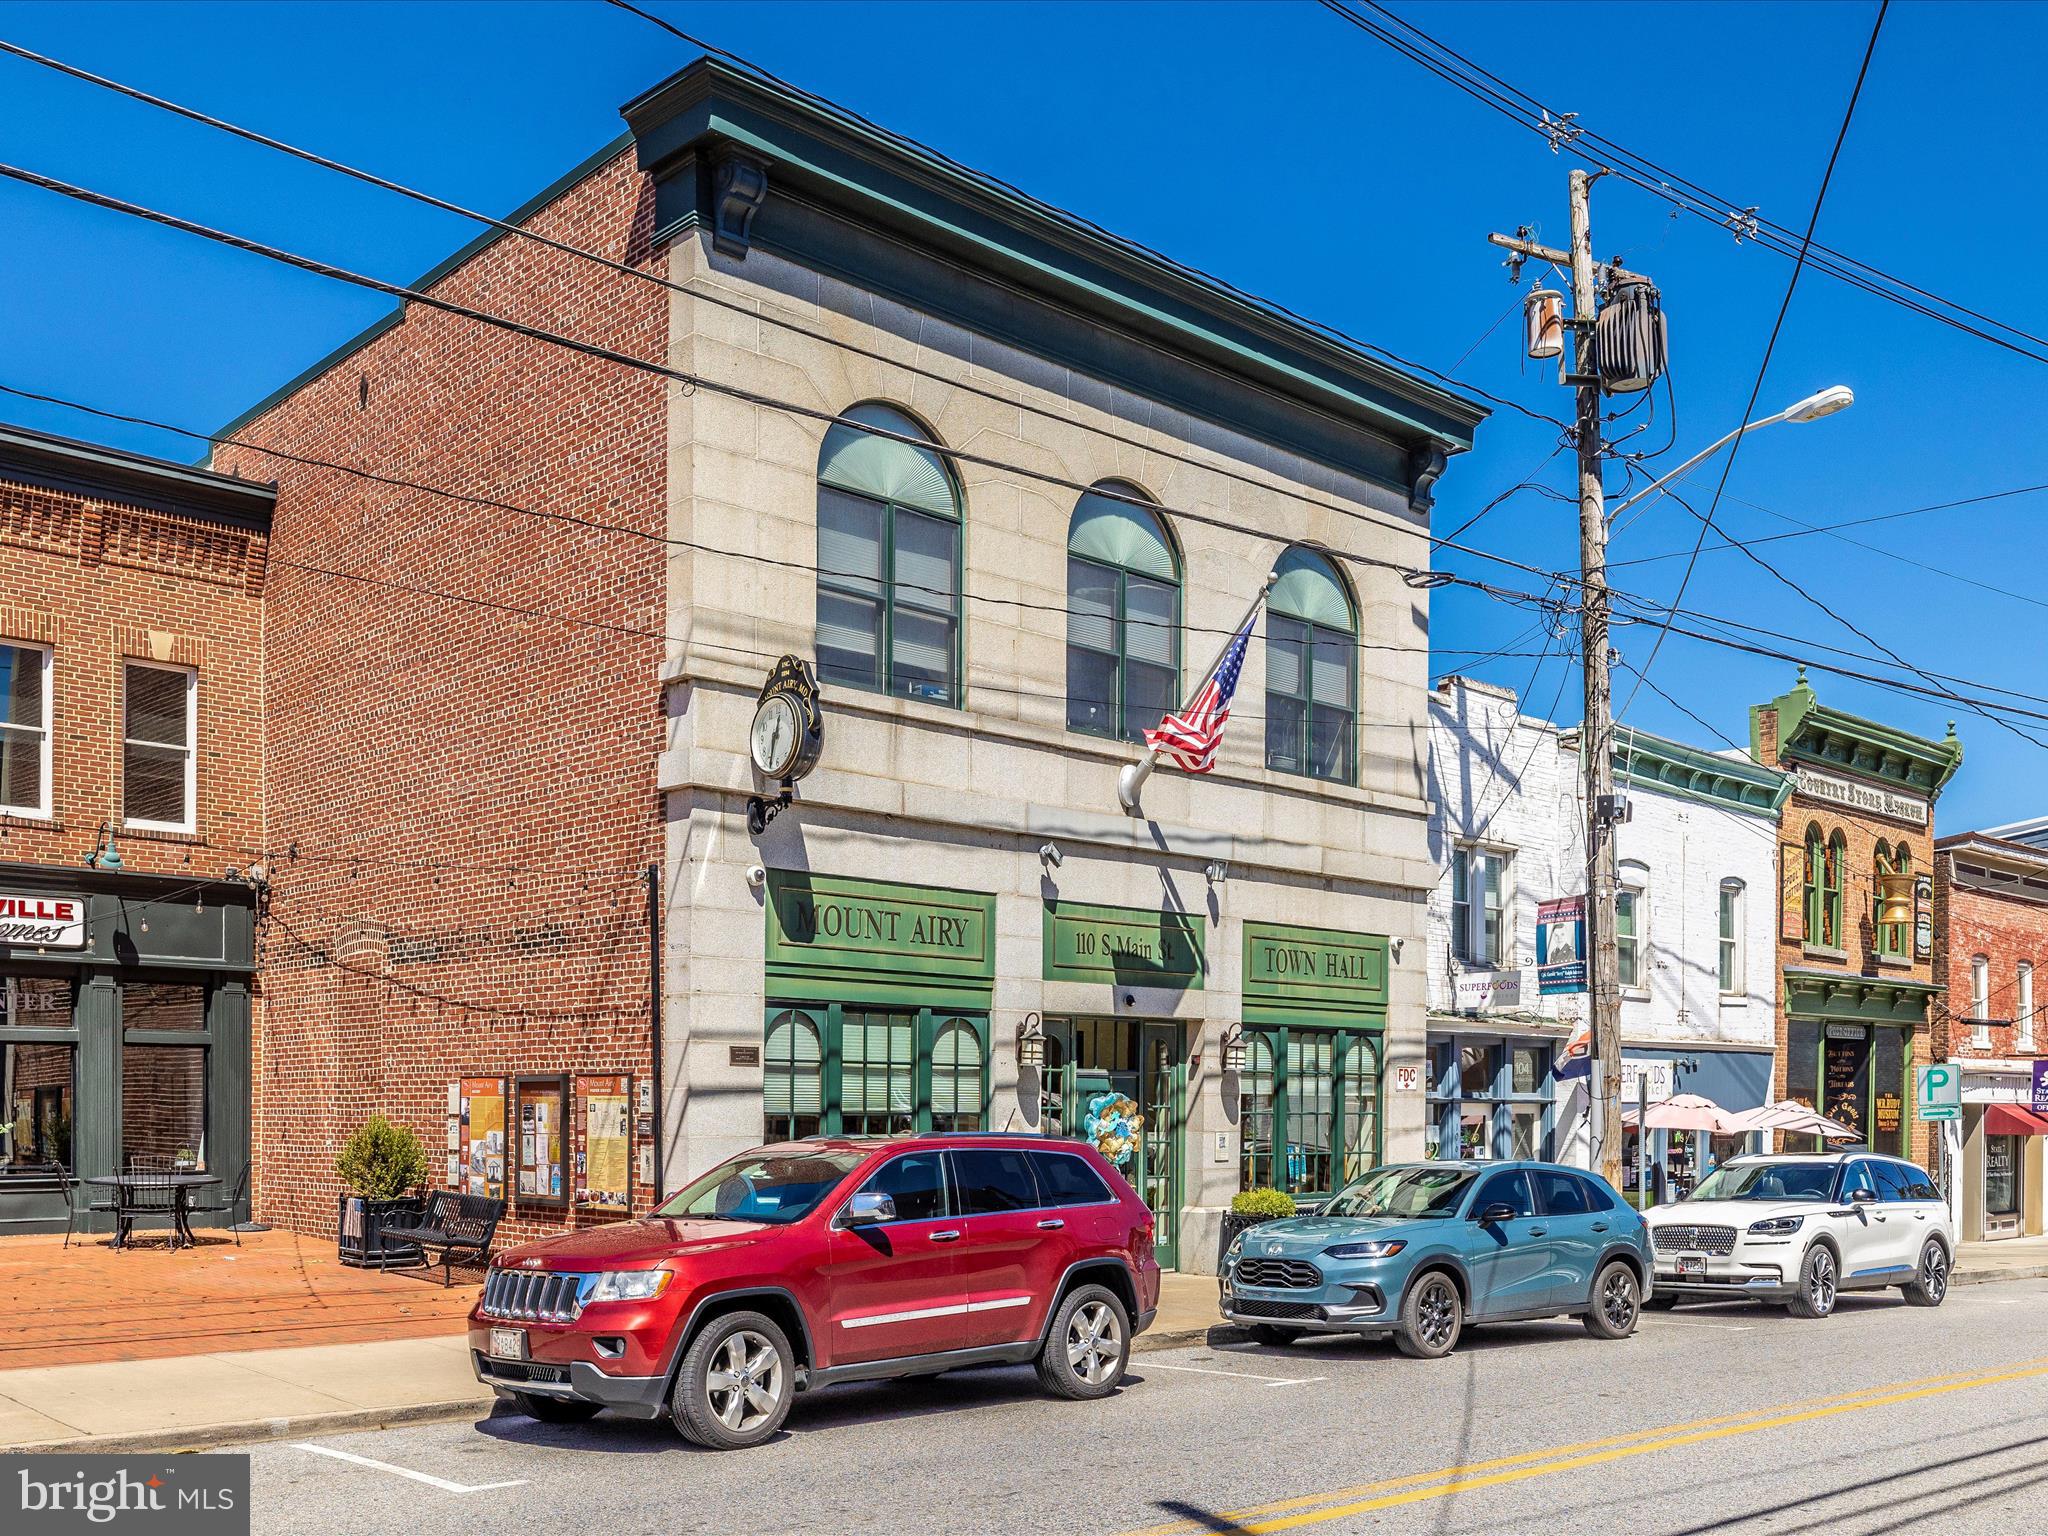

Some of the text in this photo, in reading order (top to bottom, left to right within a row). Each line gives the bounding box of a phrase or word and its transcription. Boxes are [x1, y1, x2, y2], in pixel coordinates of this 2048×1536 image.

[1799, 768, 1846, 800] COUNTRY
[797, 901, 970, 948] MOUNT AIRY
[1076, 932, 1096, 955] 110
[1102, 934, 1112, 956] S.
[1116, 936, 1152, 960] Main
[1264, 947, 1368, 980] TOWN HALL
[1460, 980, 1518, 992] SUPERFOODS
[1398, 1068, 1416, 1082] FDC
[1516, 1062, 1530, 1075] 104
[1927, 1070, 1949, 1102] P
[1986, 1154, 2010, 1168] REALTY
